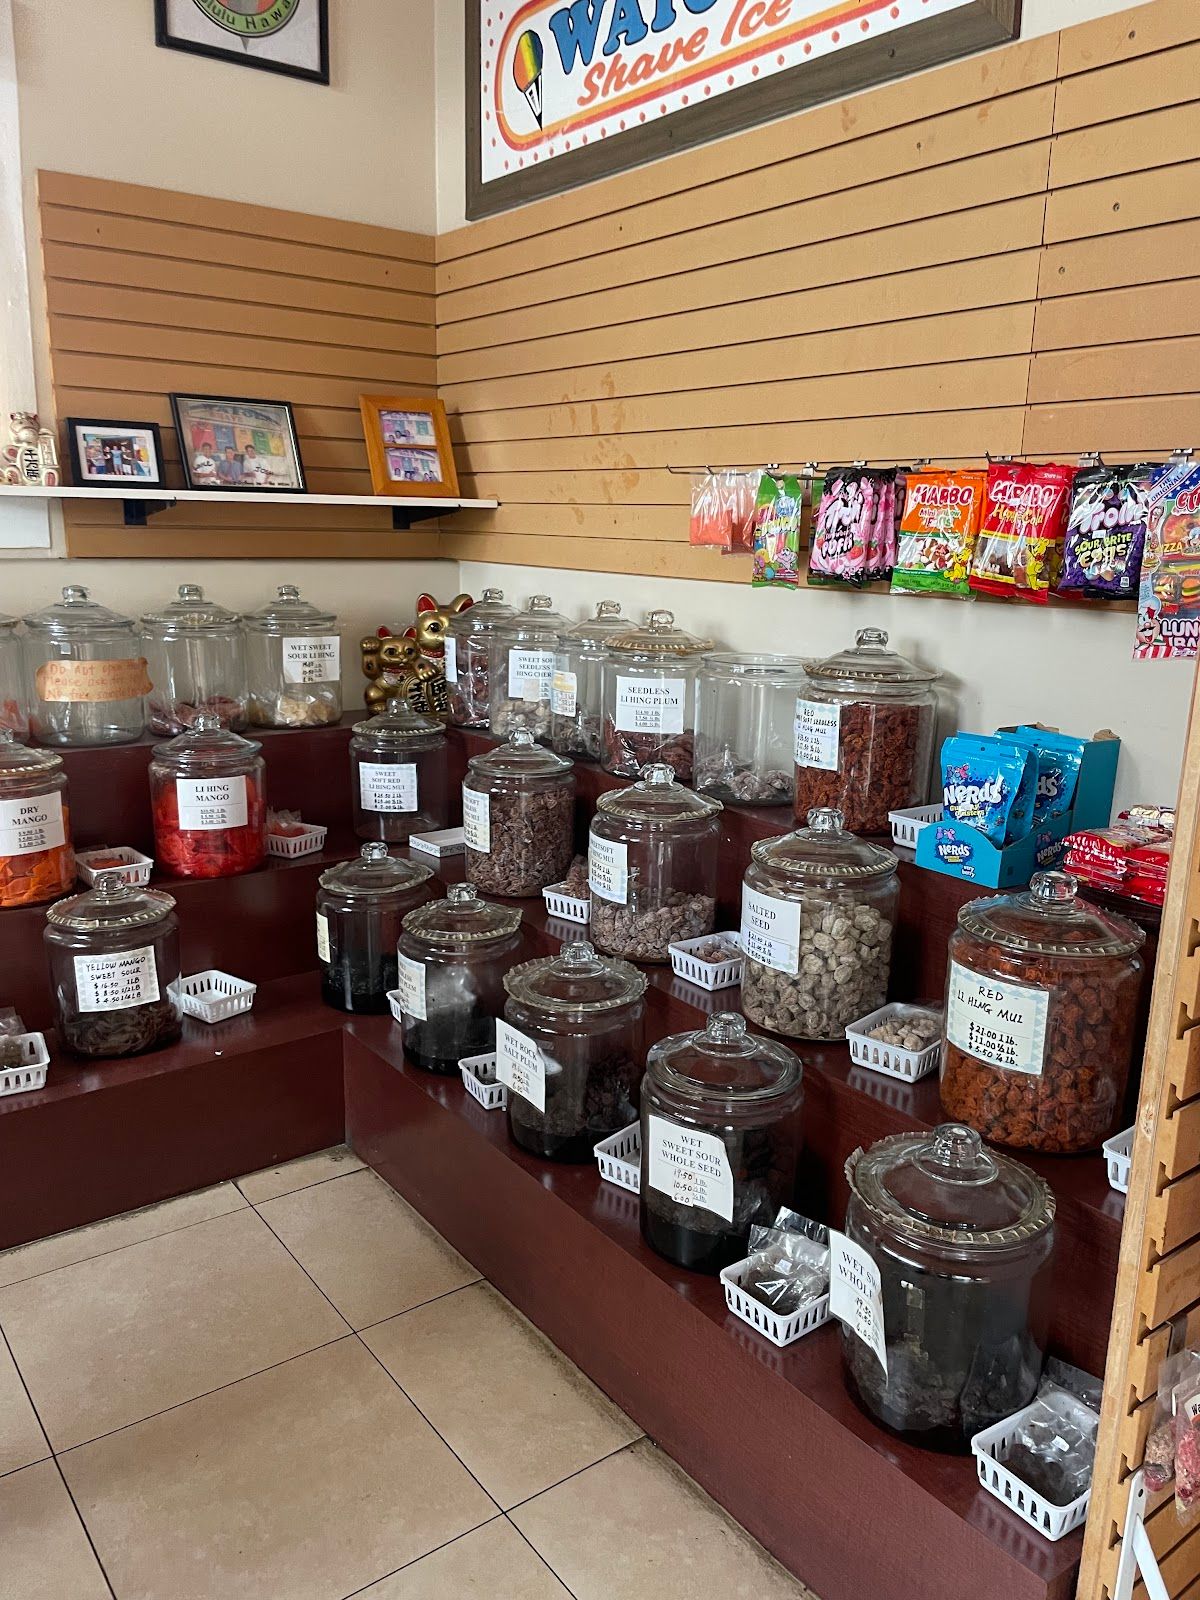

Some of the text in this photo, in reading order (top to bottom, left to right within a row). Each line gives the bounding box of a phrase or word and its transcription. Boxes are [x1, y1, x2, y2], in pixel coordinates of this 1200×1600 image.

[577, 0, 792, 106] Shave Ice
[1075, 540, 1102, 556] SOUR
[308, 643, 333, 651] SWEET
[287, 652, 308, 660] SOUR
[50, 663, 66, 675] Do
[627, 686, 670, 695] SEEDLESS
[630, 696, 652, 705] HING
[653, 697, 678, 705] PLUM
[803, 708, 815, 717] RED
[206, 784, 230, 792] HING
[195, 793, 230, 802] MANGO
[20, 805, 40, 815] DRY
[12, 813, 48, 825] MANGO
[747, 901, 776, 920] SALTED
[751, 915, 770, 931] SEED
[86, 956, 146, 972] YELLOW MANGO
[90, 966, 142, 981] SWEET SOUR
[978, 985, 1004, 1001] RED
[957, 989, 1024, 1024] LI HING MUI
[504, 1033, 537, 1061] WET ROCK
[503, 1044, 538, 1073] SALT PLUM
[680, 1135, 703, 1148] WET
[662, 1139, 722, 1167] SWEET SOUR
[661, 1149, 721, 1178] WHOLE SEED
[842, 1250, 865, 1276] WET
